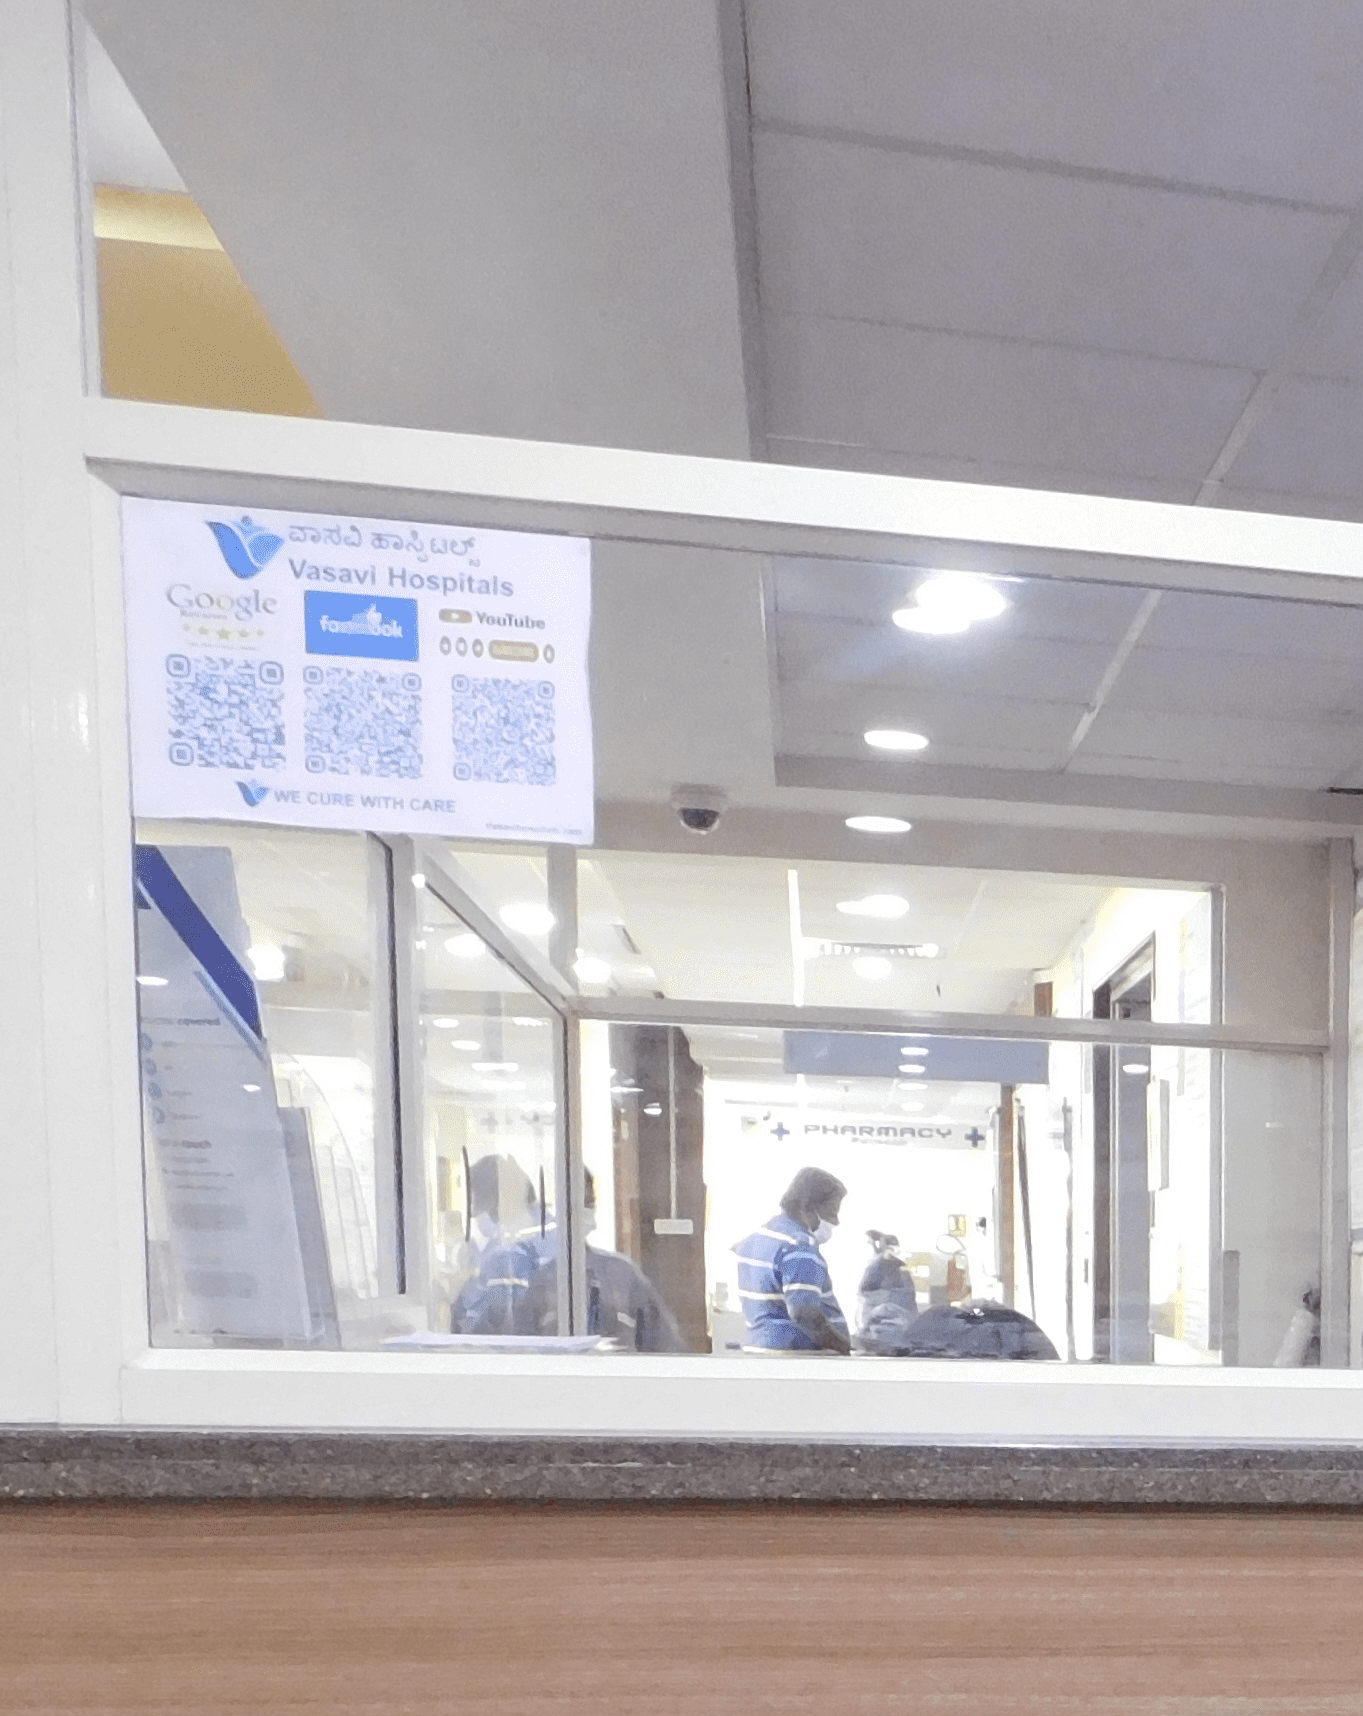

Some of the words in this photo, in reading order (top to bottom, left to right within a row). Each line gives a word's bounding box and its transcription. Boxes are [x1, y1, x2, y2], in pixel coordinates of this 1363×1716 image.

[288, 558, 377, 586] Vasavi
[388, 567, 515, 597] Hospitals
[166, 583, 278, 622] Google
[475, 610, 546, 630] YouTube
[273, 789, 301, 805] WE
[306, 791, 355, 807] CURE
[360, 794, 405, 811] WITH
[409, 798, 457, 814] CARE
[803, 1123, 954, 1140] PHARMACY
